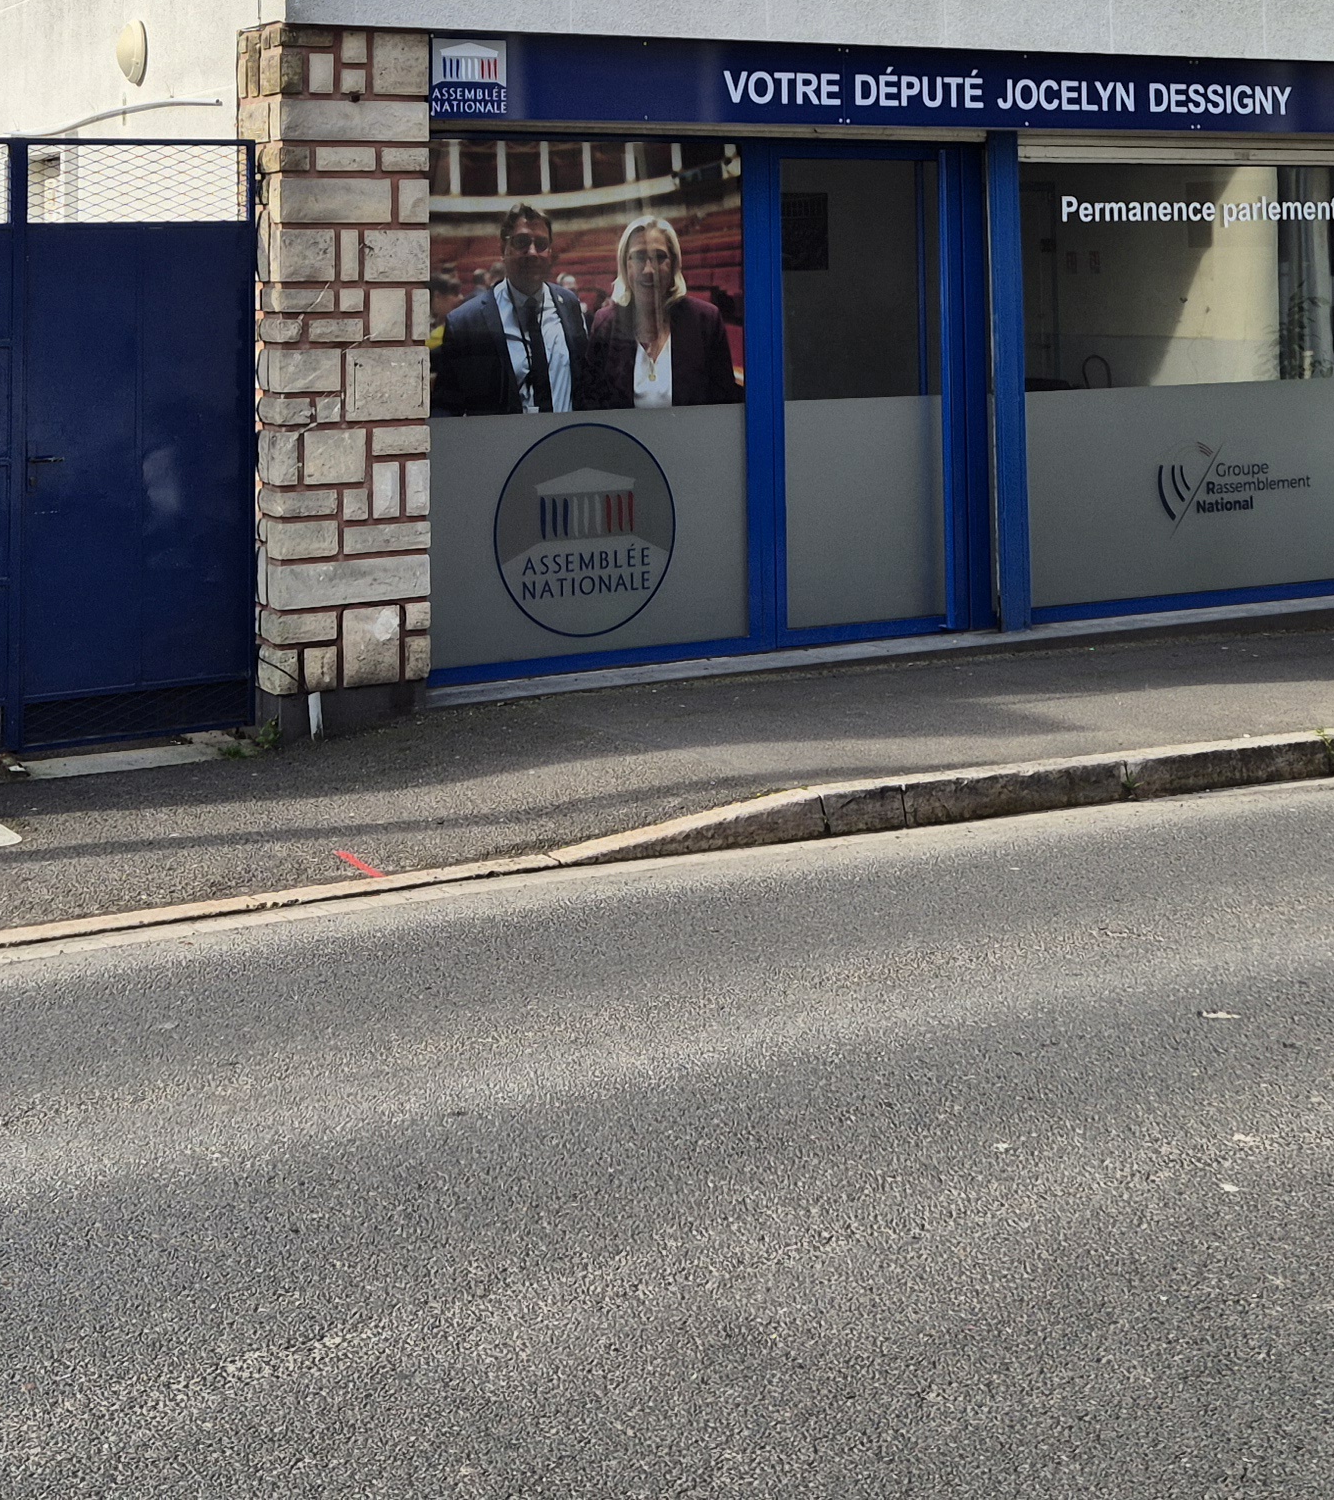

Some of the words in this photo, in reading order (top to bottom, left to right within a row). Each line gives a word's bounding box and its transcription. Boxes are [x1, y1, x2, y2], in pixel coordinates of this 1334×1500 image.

[432, 86, 507, 101] ASSEMBLÉE
[723, 70, 841, 105] VOTRE
[854, 66, 984, 108] DÉPUTÉ
[997, 79, 1135, 111] JOCELYN
[1149, 82, 1292, 115] DESSIGNY
[432, 101, 507, 114] NATIONALE
[1061, 195, 1216, 222] Permanence
[1215, 462, 1269, 478] Groupe
[1206, 475, 1311, 495] Rassemblement
[1196, 495, 1254, 514] National
[522, 543, 651, 576] ASSEMBLÉE
[522, 571, 651, 601] NATIONALE
